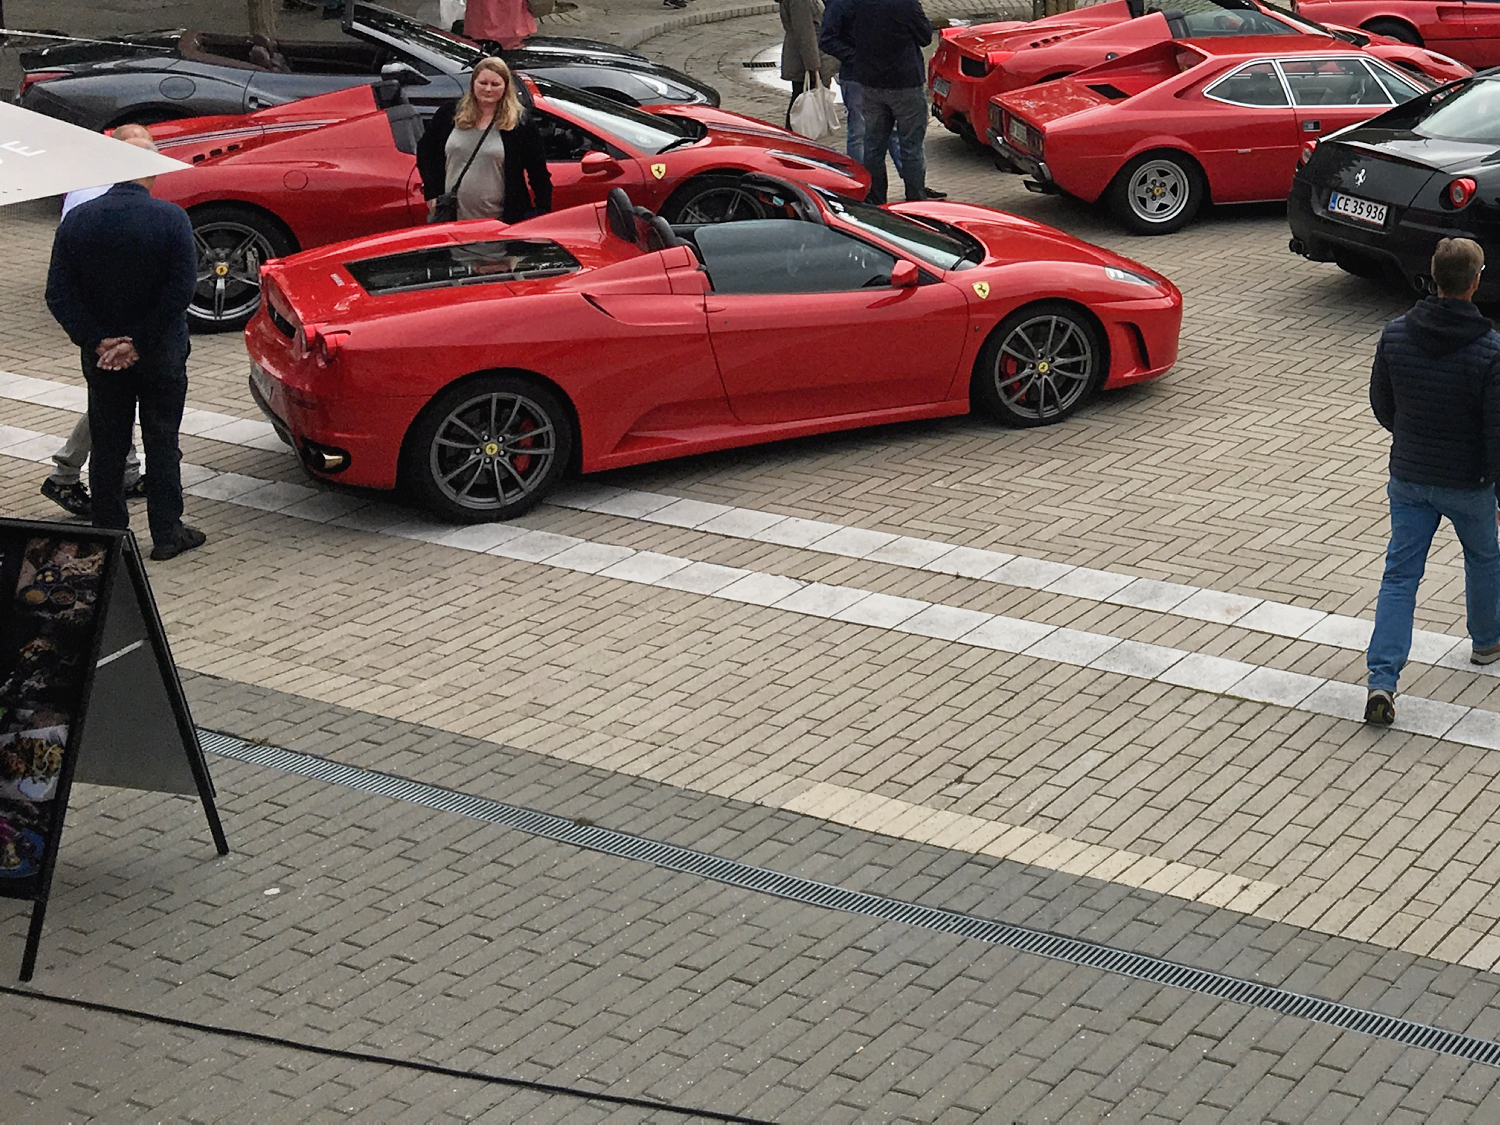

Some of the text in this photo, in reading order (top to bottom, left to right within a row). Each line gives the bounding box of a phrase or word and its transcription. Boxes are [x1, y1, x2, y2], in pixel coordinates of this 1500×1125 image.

[1337, 196, 1385, 221] CE 35 936
